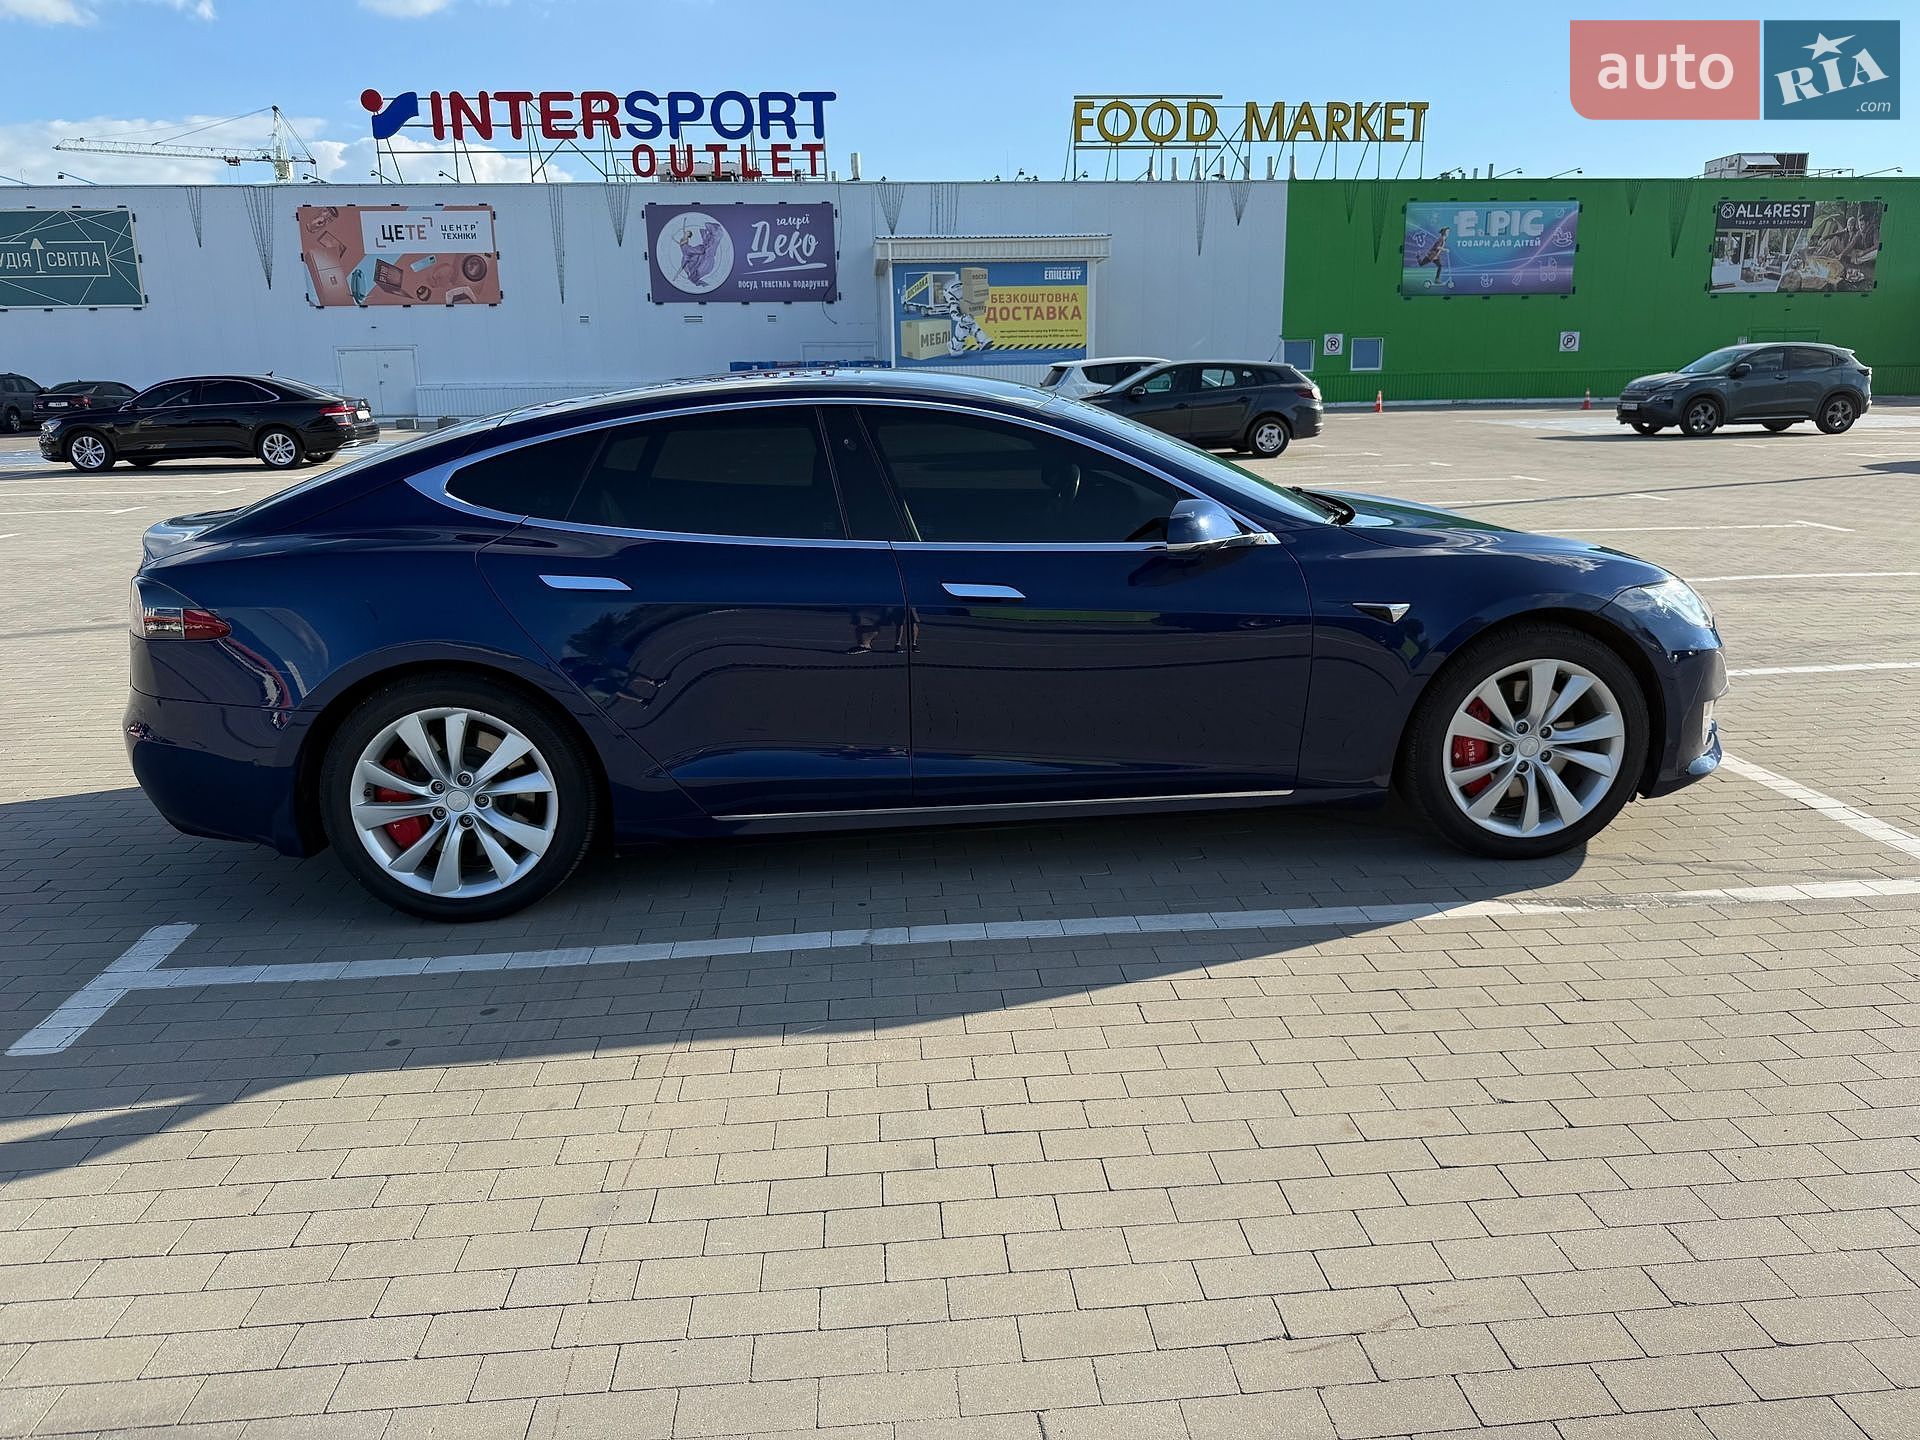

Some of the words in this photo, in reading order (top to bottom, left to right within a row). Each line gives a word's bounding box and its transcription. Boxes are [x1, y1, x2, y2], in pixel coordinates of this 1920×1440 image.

[430, 90, 837, 141] INTERSPORT
[1074, 100, 1218, 143] FOOD
[1245, 101, 1430, 142] MARKET
[632, 143, 825, 178] OUTLET
[1735, 203, 1811, 218] ALL4REST
[381, 224, 427, 243] ЦЕТЕ
[440, 224, 476, 232] ЦЕНТР
[441, 232, 477, 240] ТЕХНІКИ
[746, 221, 819, 266] Деко
[1492, 240, 1512, 248] ДЛЯ
[46, 251, 101, 267] СВІТЛА
[990, 293, 1079, 304] БЕЗКОШТОВНА
[985, 305, 1082, 324] ДОСТАВКА
